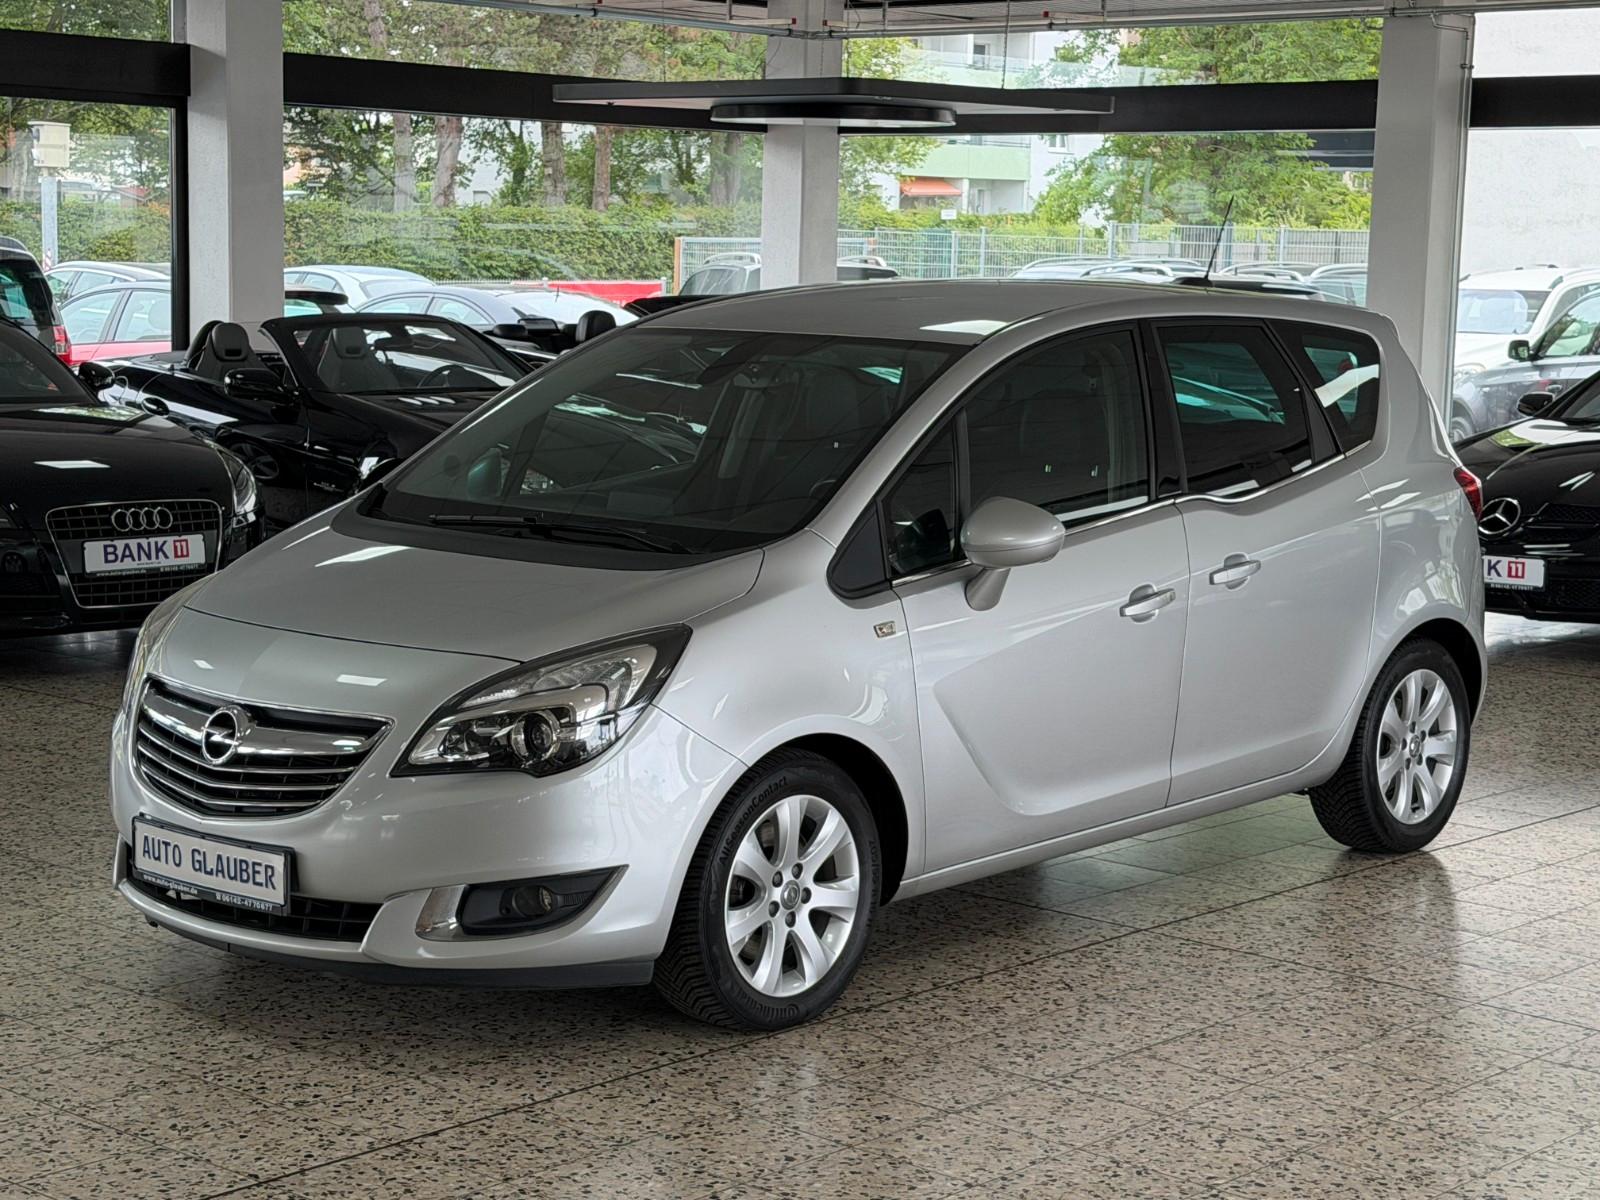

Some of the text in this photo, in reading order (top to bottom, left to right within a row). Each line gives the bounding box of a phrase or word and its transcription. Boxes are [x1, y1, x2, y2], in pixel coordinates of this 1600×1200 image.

[103, 540, 188, 564] BANK 11
[1508, 561, 1524, 578] 11
[142, 835, 276, 890] AUTO GLAUBER
